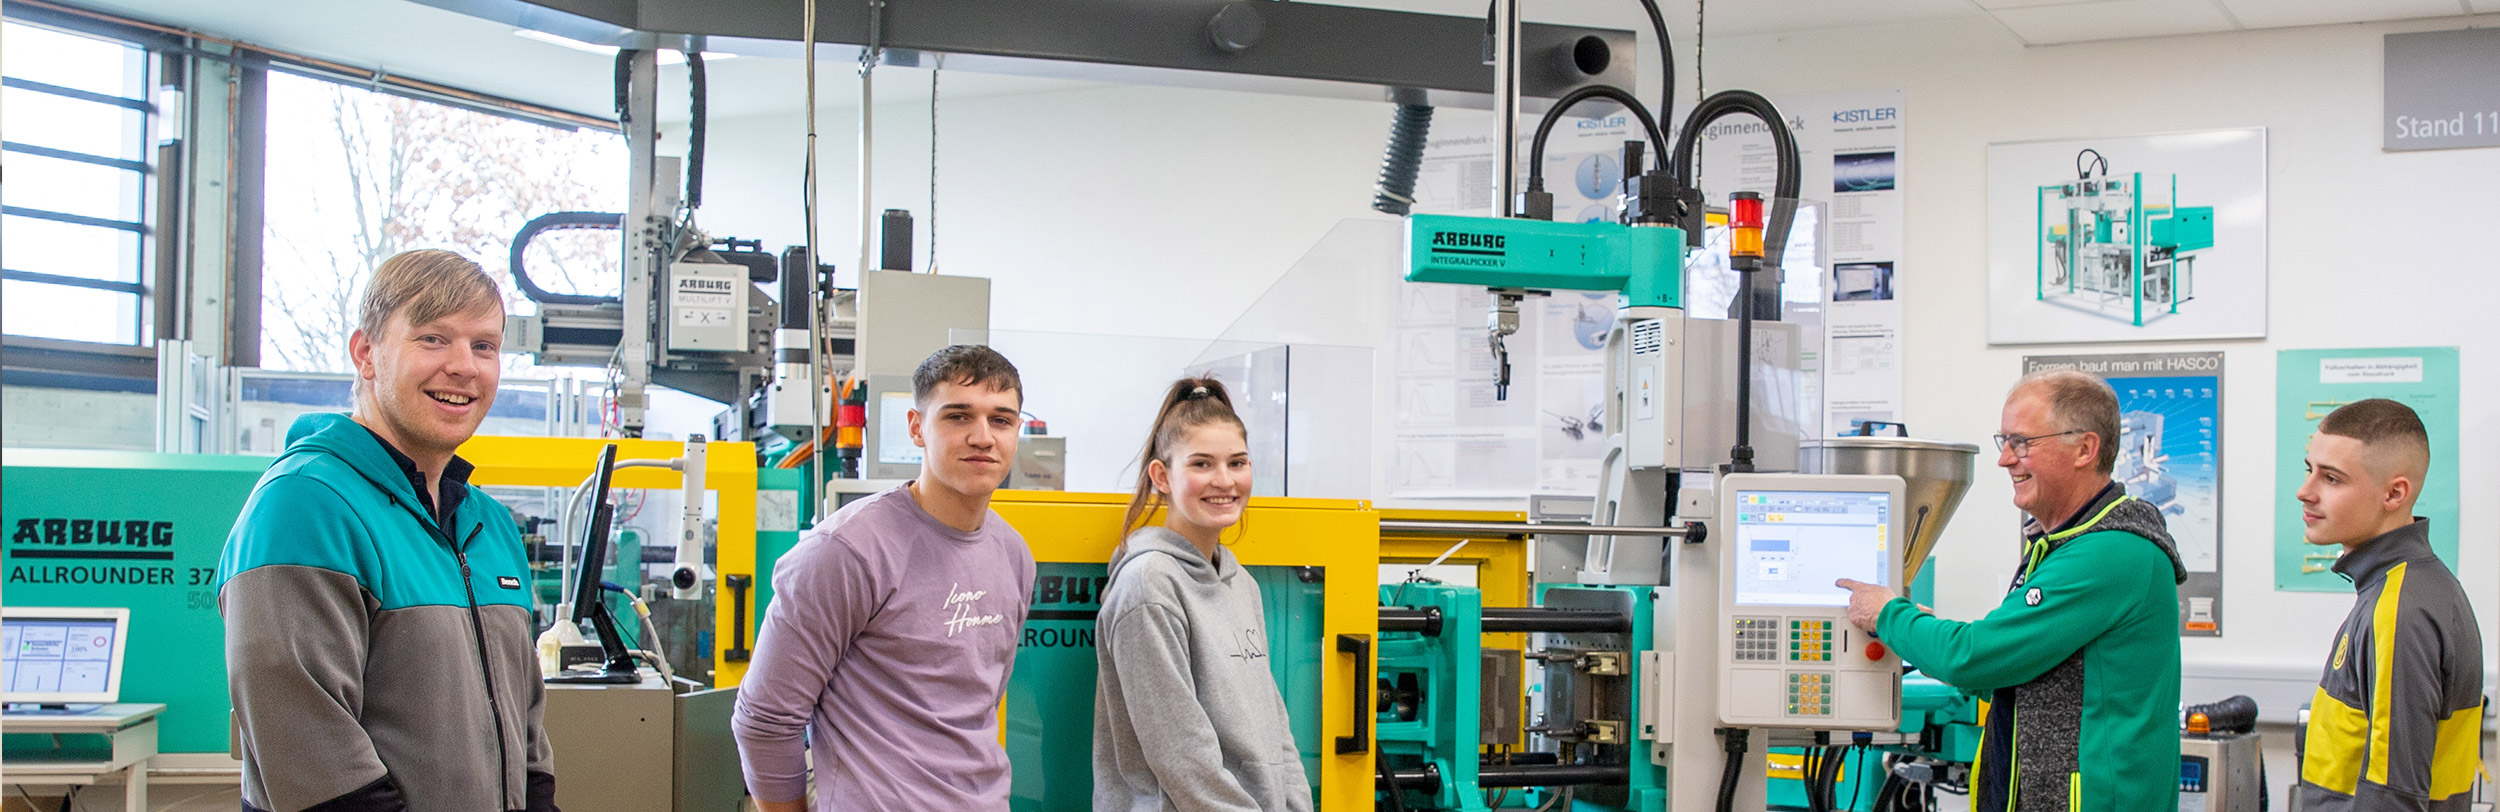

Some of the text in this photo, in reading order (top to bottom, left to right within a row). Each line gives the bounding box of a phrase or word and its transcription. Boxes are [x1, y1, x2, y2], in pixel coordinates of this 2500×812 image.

[1833, 107, 1896, 122] KISTLER
[2396, 111, 2498, 139] Stand 11
[1432, 232, 1505, 249] ARBURG
[1431, 256, 1506, 267] INTEGRALPICKER V
[679, 279, 732, 290] ARBURG
[679, 295, 722, 304] MULTILIFT
[700, 312, 710, 323] X
[2080, 360, 2107, 372] baut
[2111, 360, 2140, 371] man
[2143, 358, 2163, 371] mit
[2167, 356, 2219, 370] HASCO
[12, 518, 173, 547] ARBURG
[10, 566, 174, 584] ALLROUNDER
[942, 582, 987, 610] Icono
